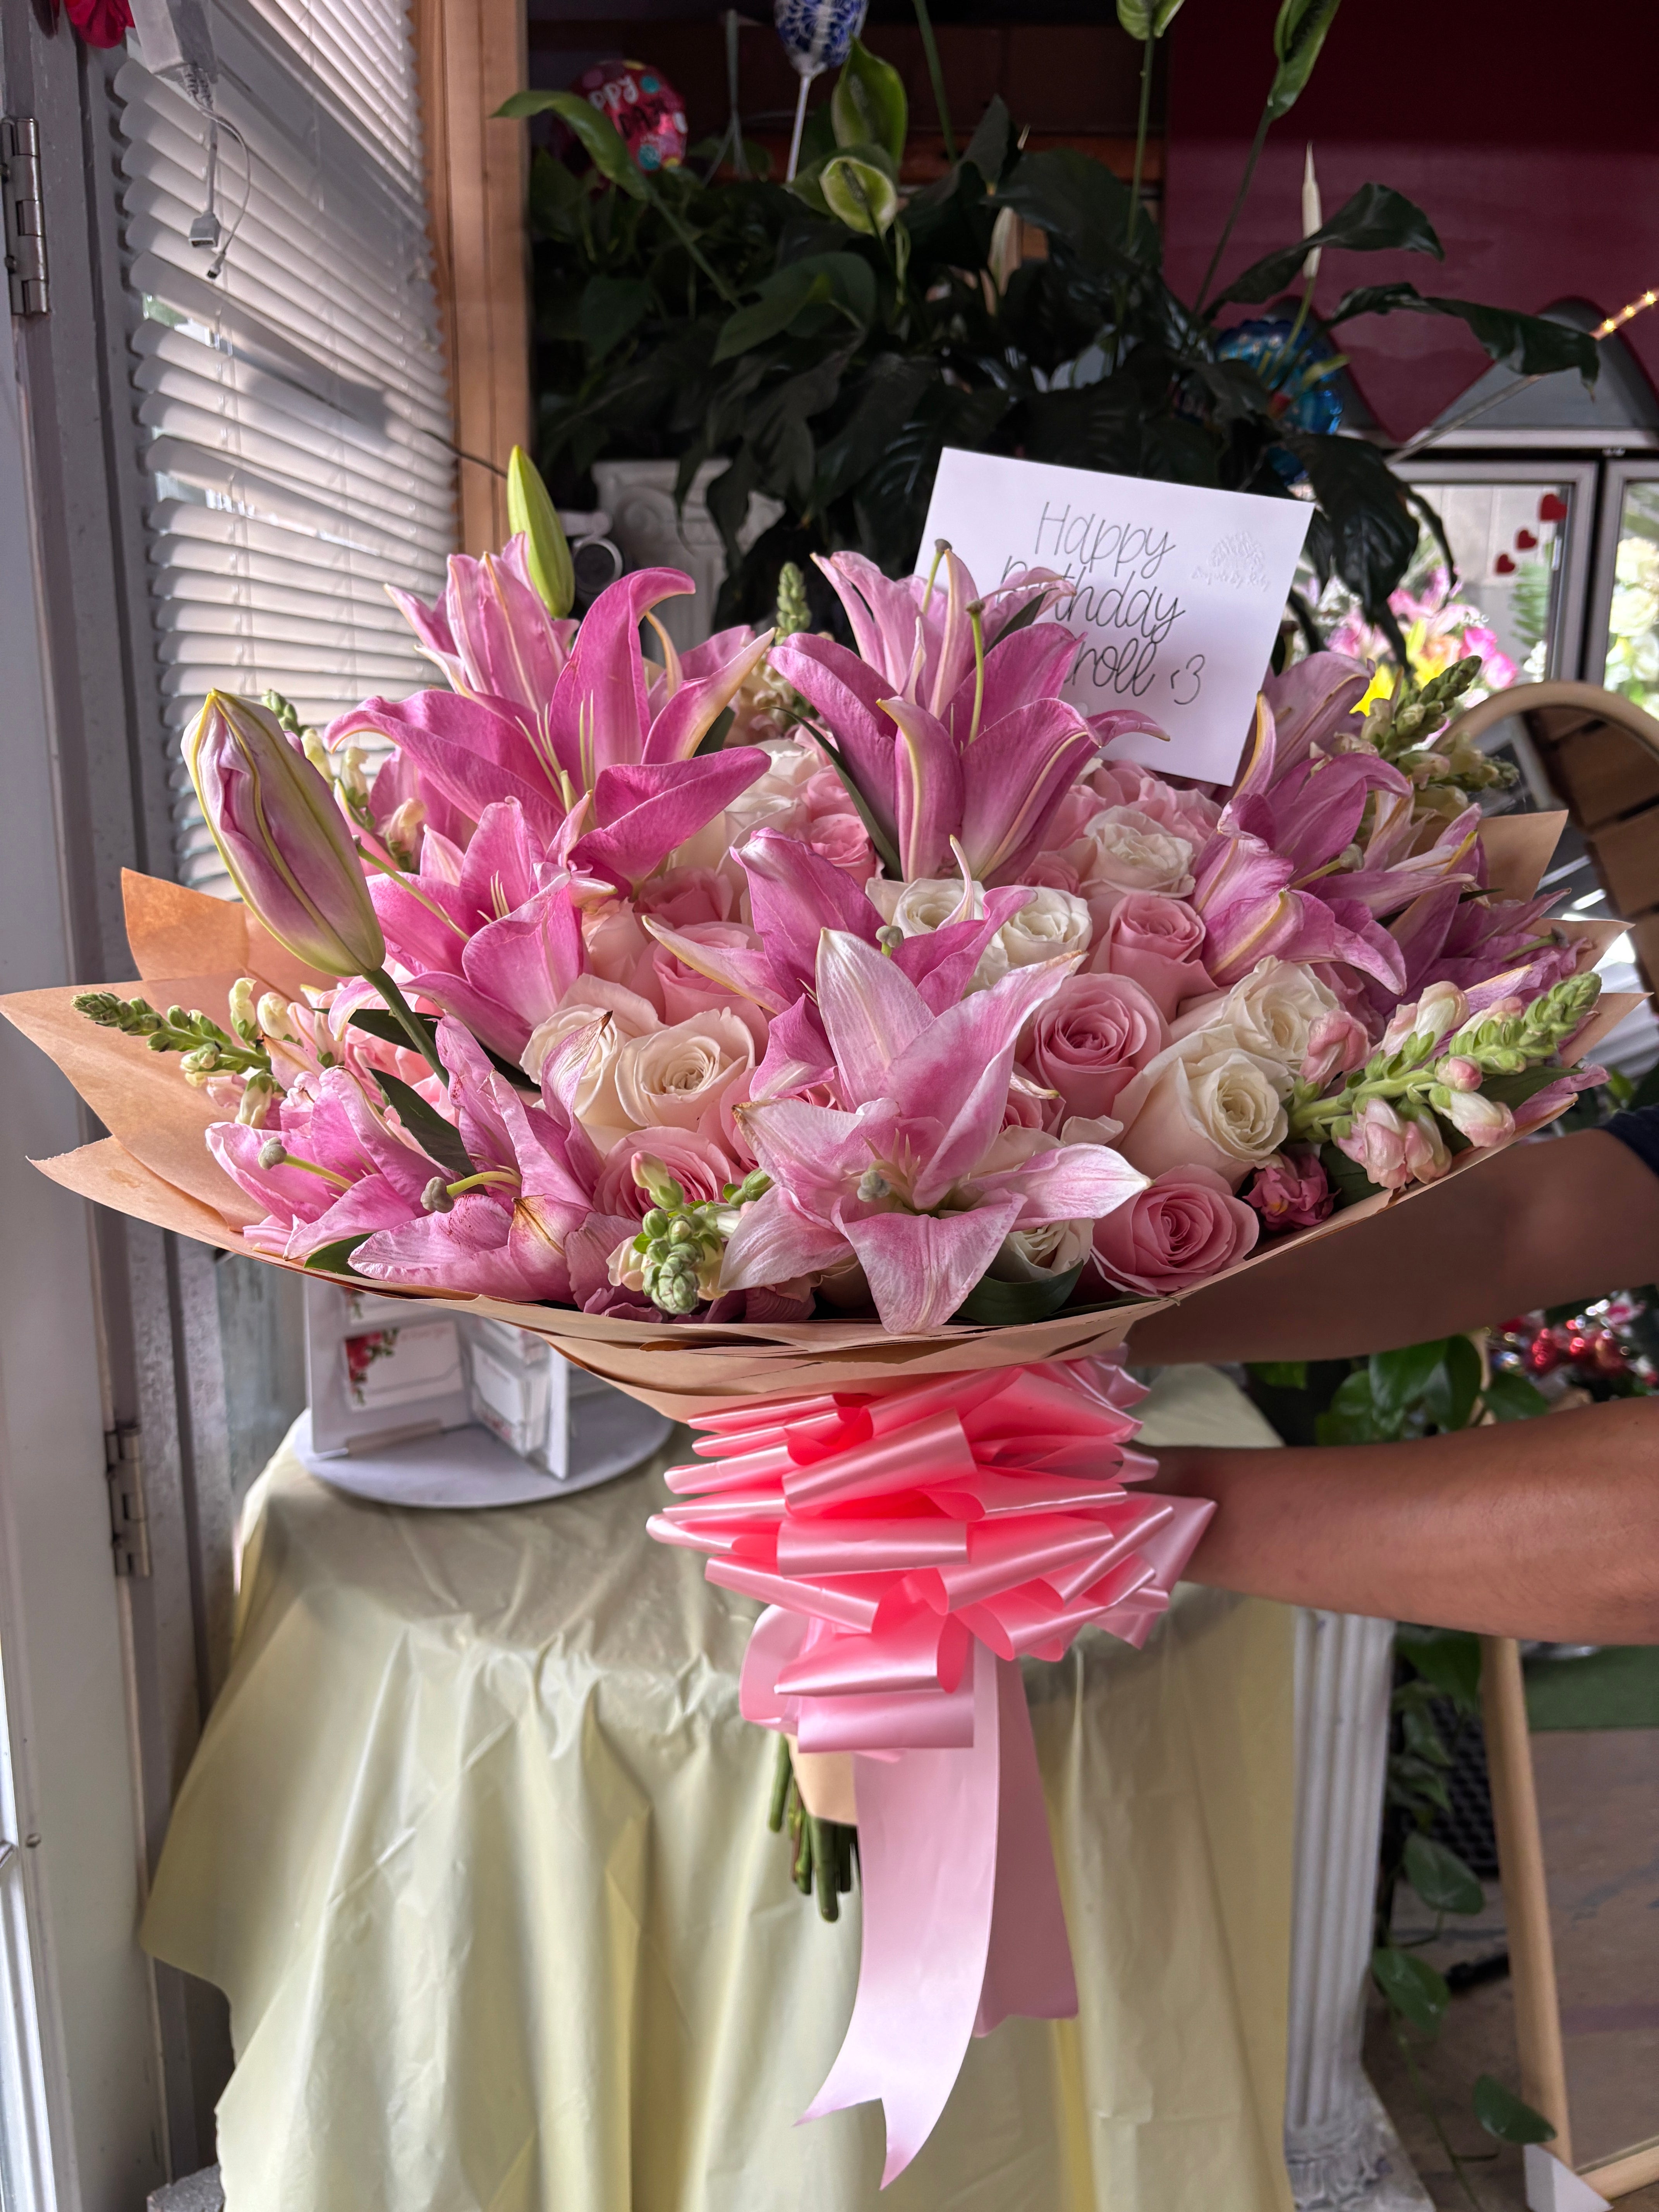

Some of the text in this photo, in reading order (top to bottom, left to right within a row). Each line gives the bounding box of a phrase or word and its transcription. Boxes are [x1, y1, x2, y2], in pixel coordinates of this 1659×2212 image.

[588, 74, 639, 112] ppy
[1034, 501, 1177, 579] Happy
[996, 555, 1186, 644] thday
